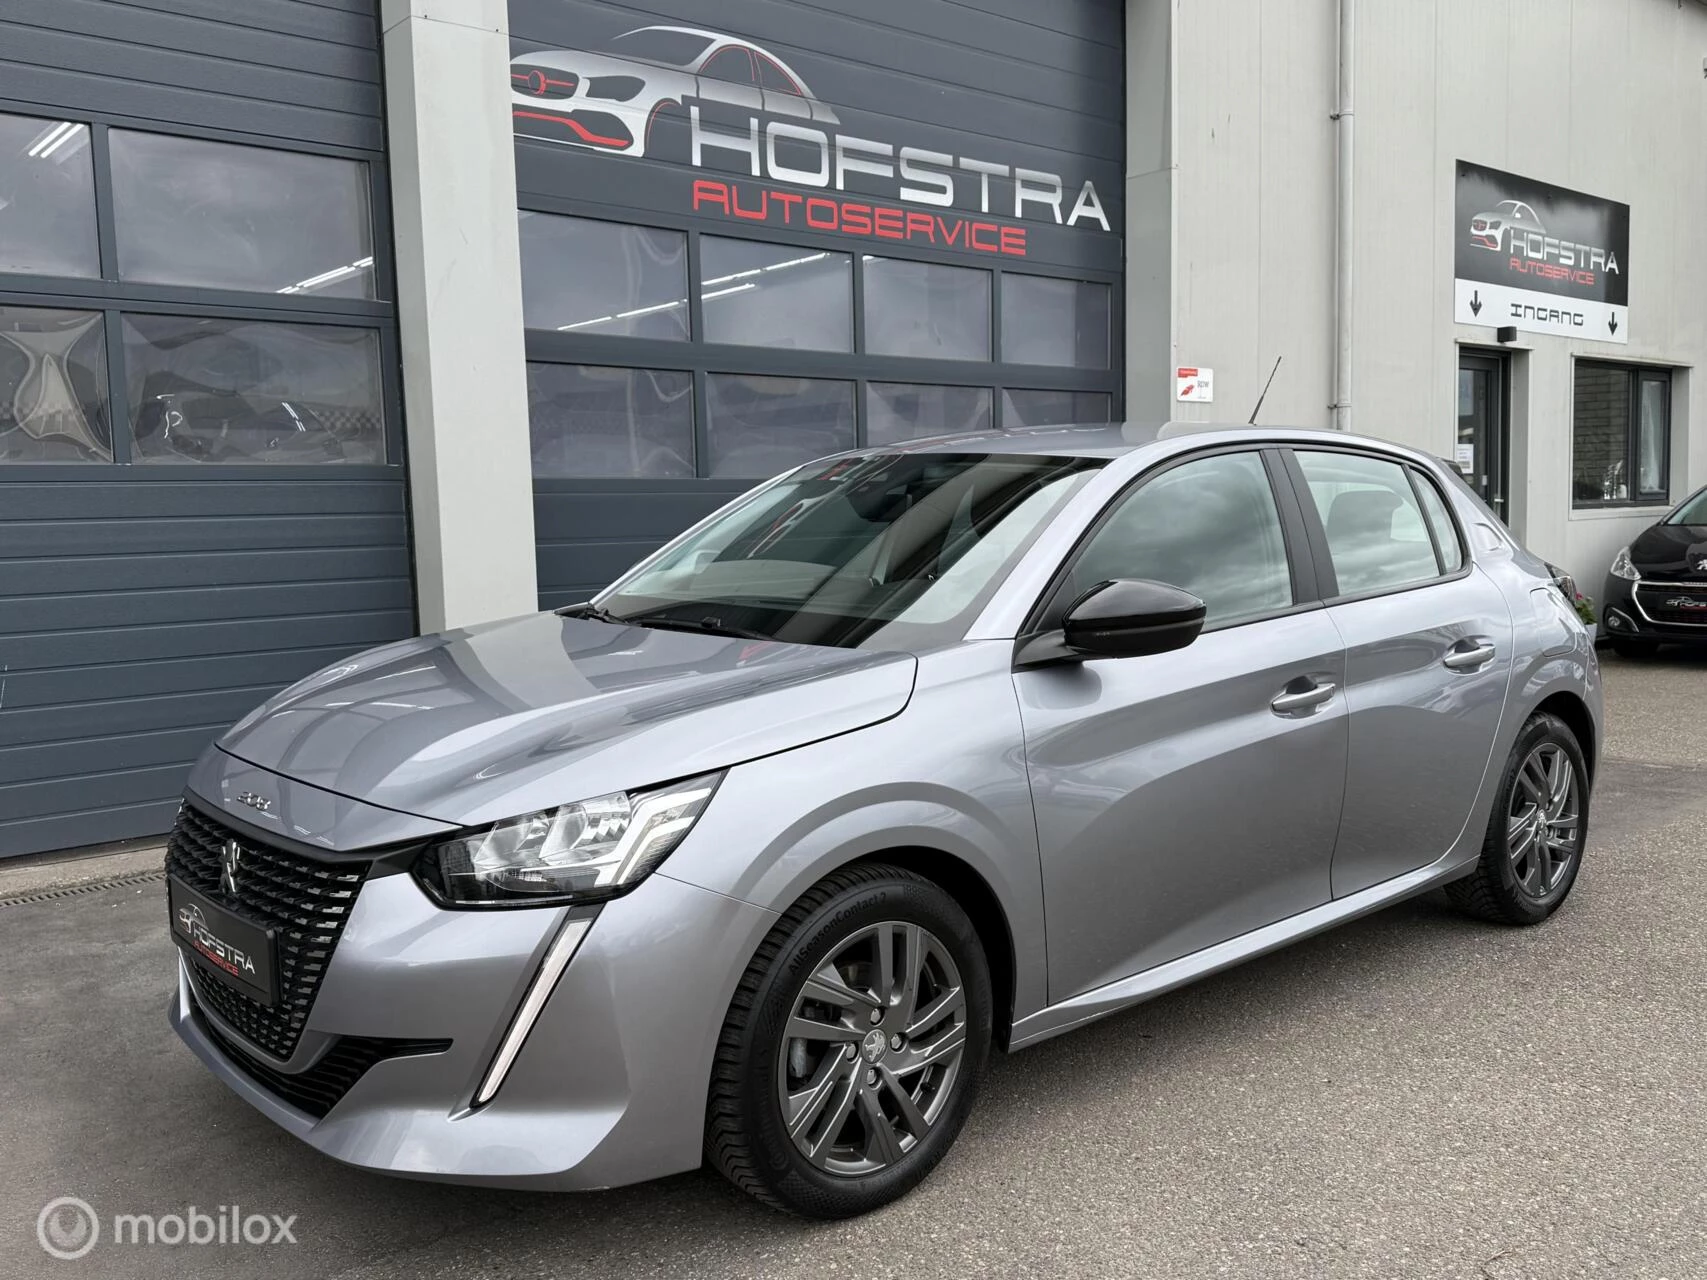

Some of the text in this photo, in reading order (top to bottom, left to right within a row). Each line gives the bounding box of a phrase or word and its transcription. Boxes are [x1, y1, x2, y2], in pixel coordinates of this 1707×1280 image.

[691, 105, 1111, 231] HOFSTRA
[693, 180, 1026, 255] AUTOSERVICE
[1509, 257, 1595, 285] AUTOSERVICE
[1510, 229, 1619, 274] HOFSTRA
[1510, 303, 1584, 326] INGANG
[193, 922, 255, 974] HOFSTRA
